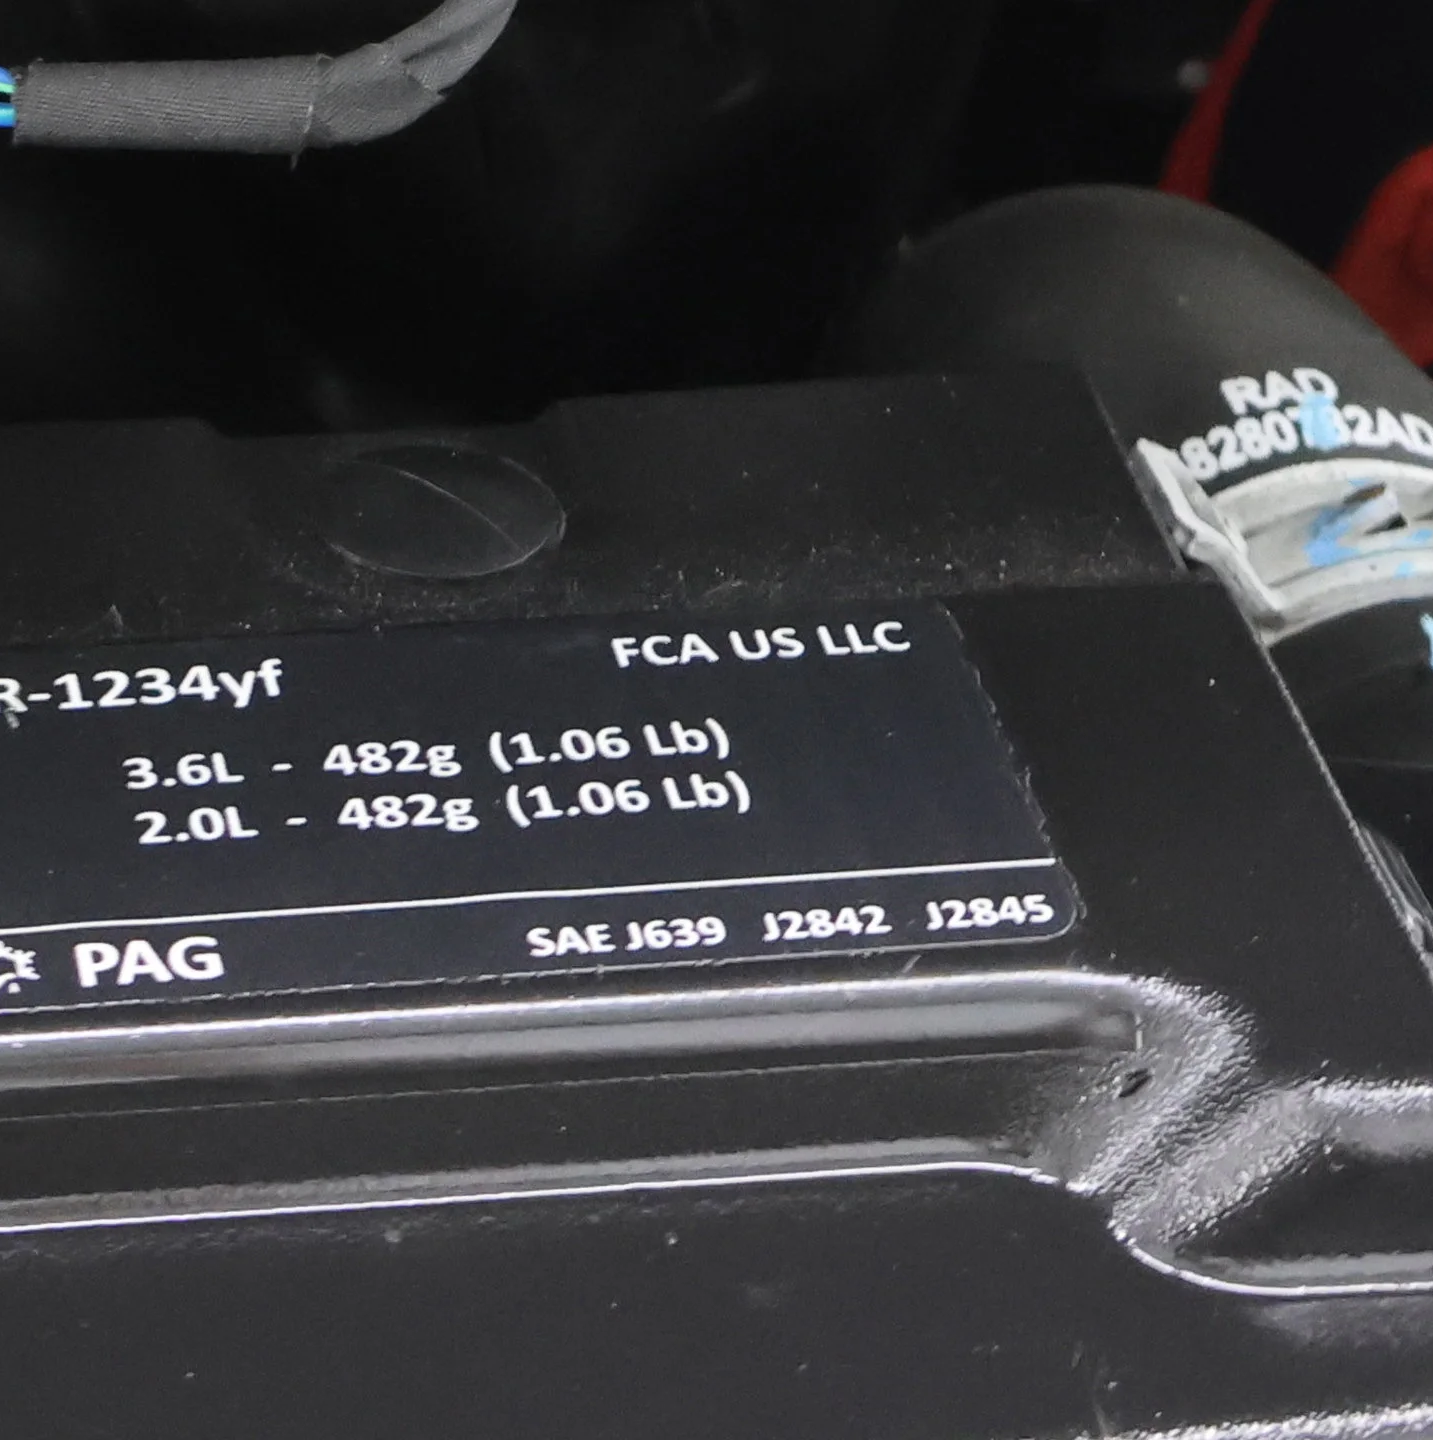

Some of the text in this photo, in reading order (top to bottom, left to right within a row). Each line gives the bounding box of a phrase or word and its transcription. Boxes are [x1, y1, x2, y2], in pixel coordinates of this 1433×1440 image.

[1220, 366, 1338, 416] RAD
[610, 621, 911, 668] FCA US LLC
[122, 752, 245, 790] 3.6L
[323, 739, 462, 778] 482g
[489, 726, 631, 774] (1.06
[642, 717, 730, 760] Lb)
[134, 805, 260, 845] 2.0L
[337, 793, 480, 832] 482g
[505, 779, 651, 829] (1.06
[661, 770, 751, 814] Lb)
[525, 893, 1055, 958] SAE J639 J2842 J2845
[73, 935, 225, 988] PAG
